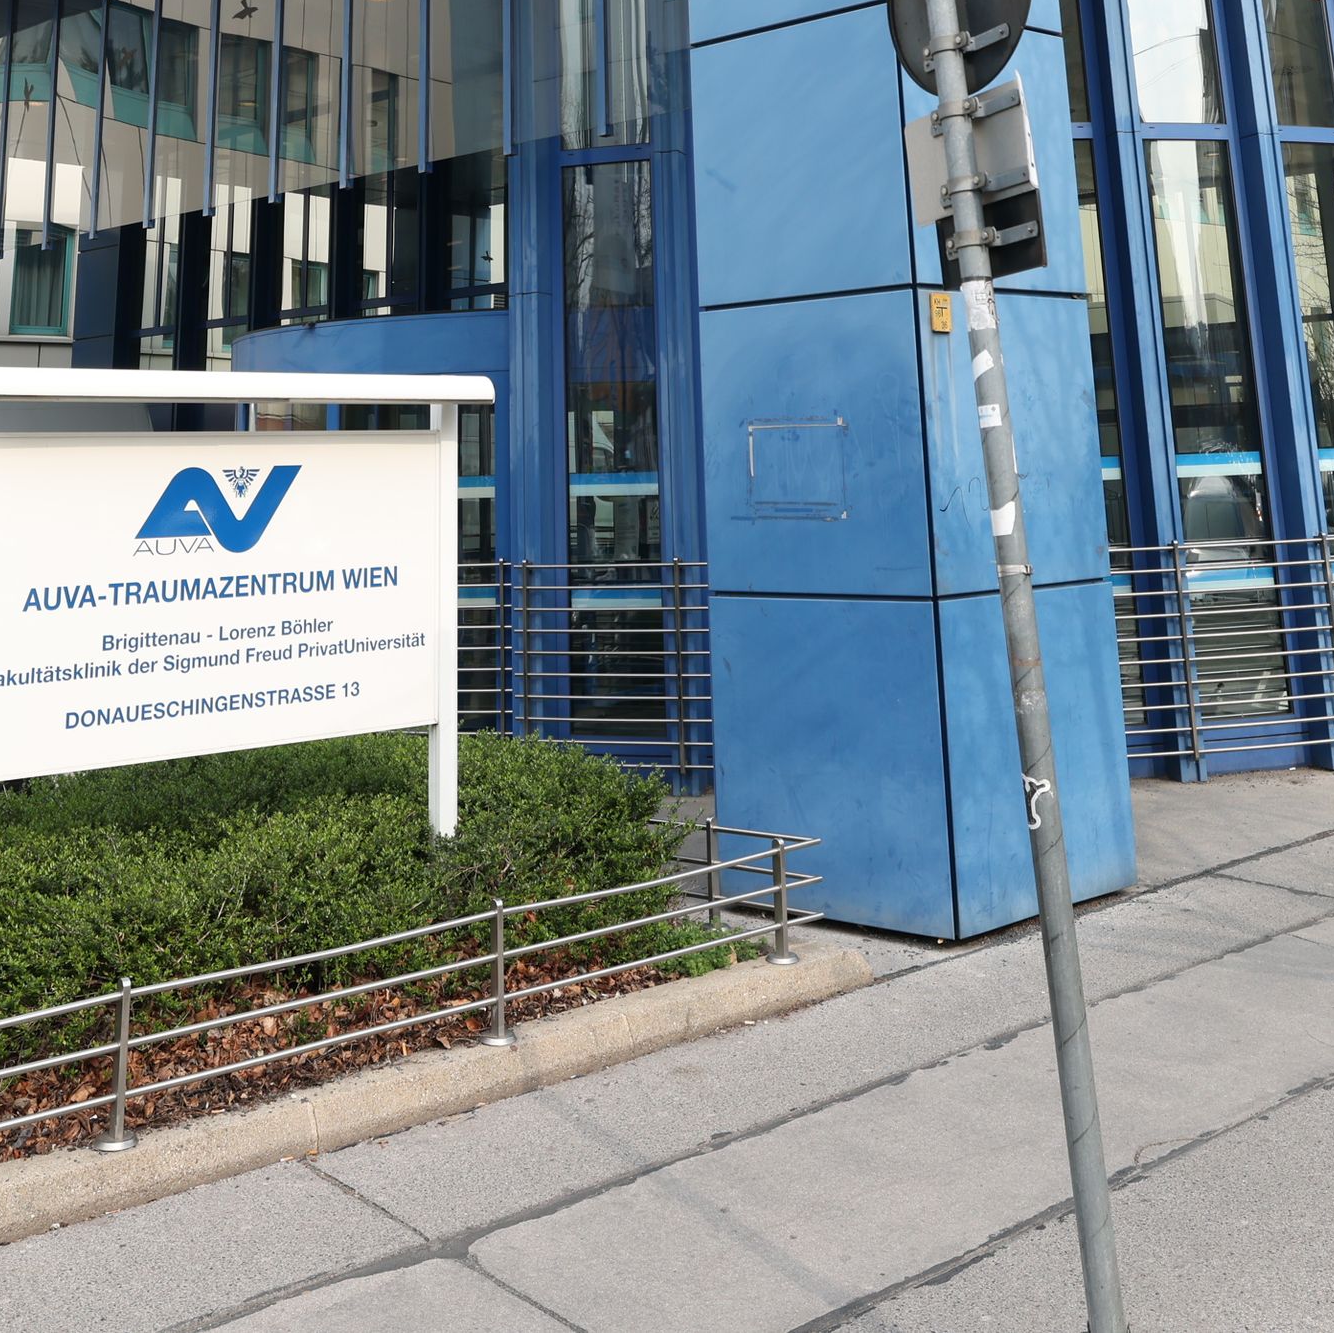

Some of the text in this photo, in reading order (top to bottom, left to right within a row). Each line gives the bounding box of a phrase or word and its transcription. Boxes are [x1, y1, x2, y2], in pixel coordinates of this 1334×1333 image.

[132, 537, 215, 557] AUVA
[22, 565, 399, 613] AUVA-TRAUMAZENTRUM WIEN
[101, 627, 201, 655] Brigittenau
[218, 620, 276, 642] Lorenz
[281, 617, 334, 637] Böhler
[127, 655, 159, 676] der
[163, 649, 241, 676] Sigmund
[245, 645, 293, 664] Freud
[298, 631, 427, 660] PrivatUniversität
[64, 680, 361, 731] DONAUESCHINGENSTRASSE 13
